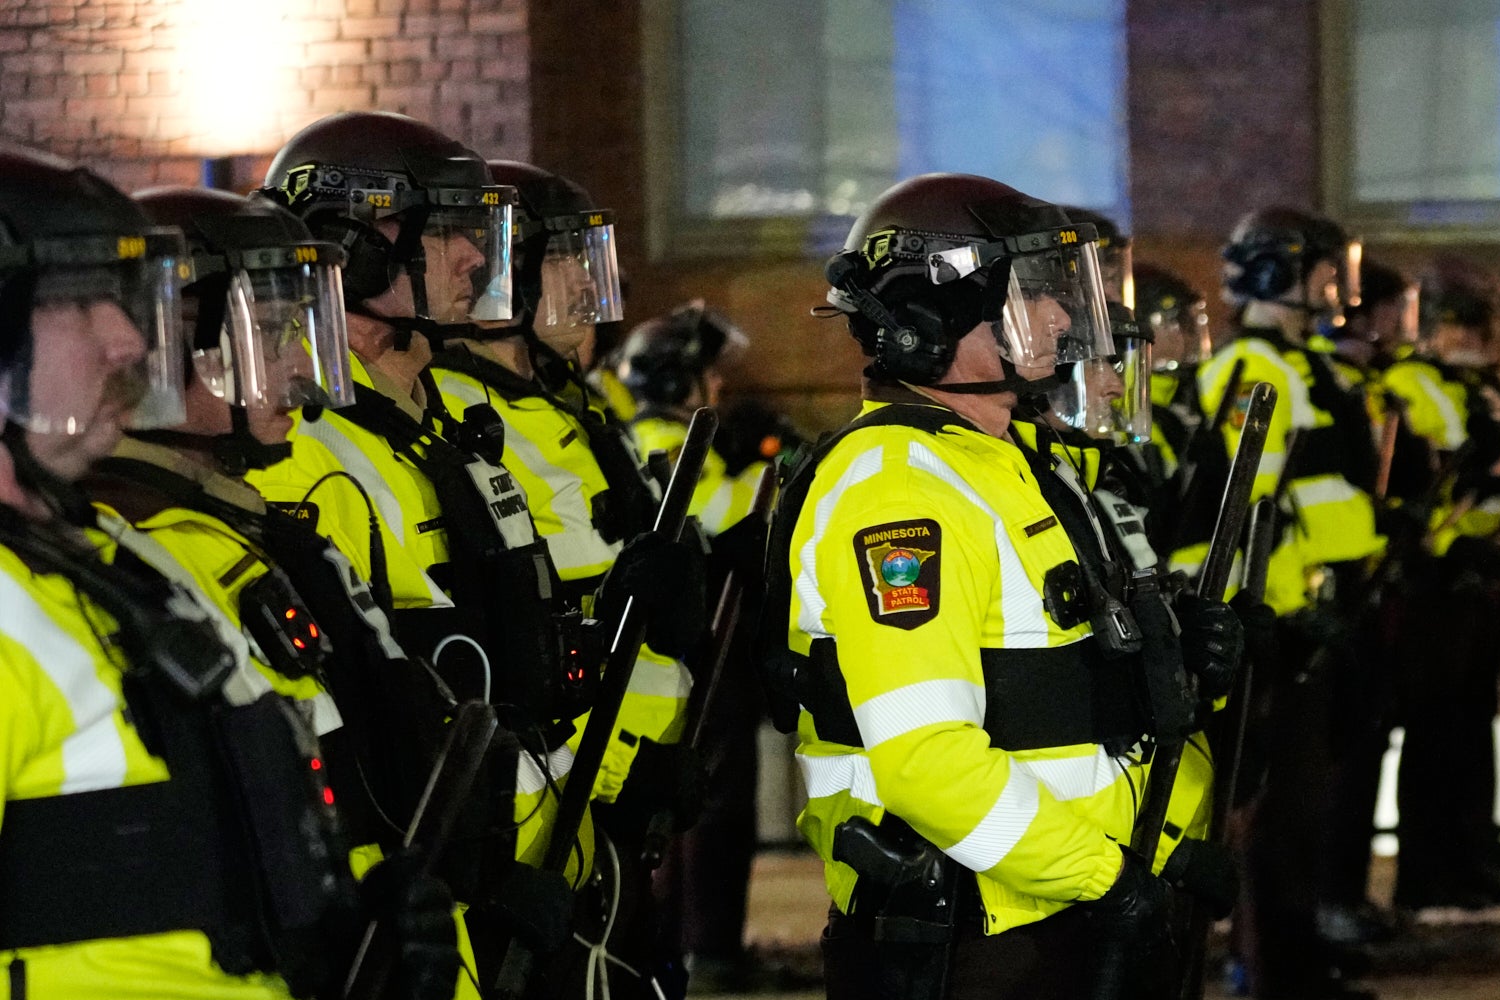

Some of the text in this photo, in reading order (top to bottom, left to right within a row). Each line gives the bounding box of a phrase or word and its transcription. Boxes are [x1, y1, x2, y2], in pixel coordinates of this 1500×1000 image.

[367, 194, 391, 207] 432
[482, 192, 499, 205] 432
[1060, 230, 1077, 244] 280
[864, 527, 930, 545] MINNESOTA
[892, 587, 919, 597] STATE
[891, 597, 924, 607] PATROL
